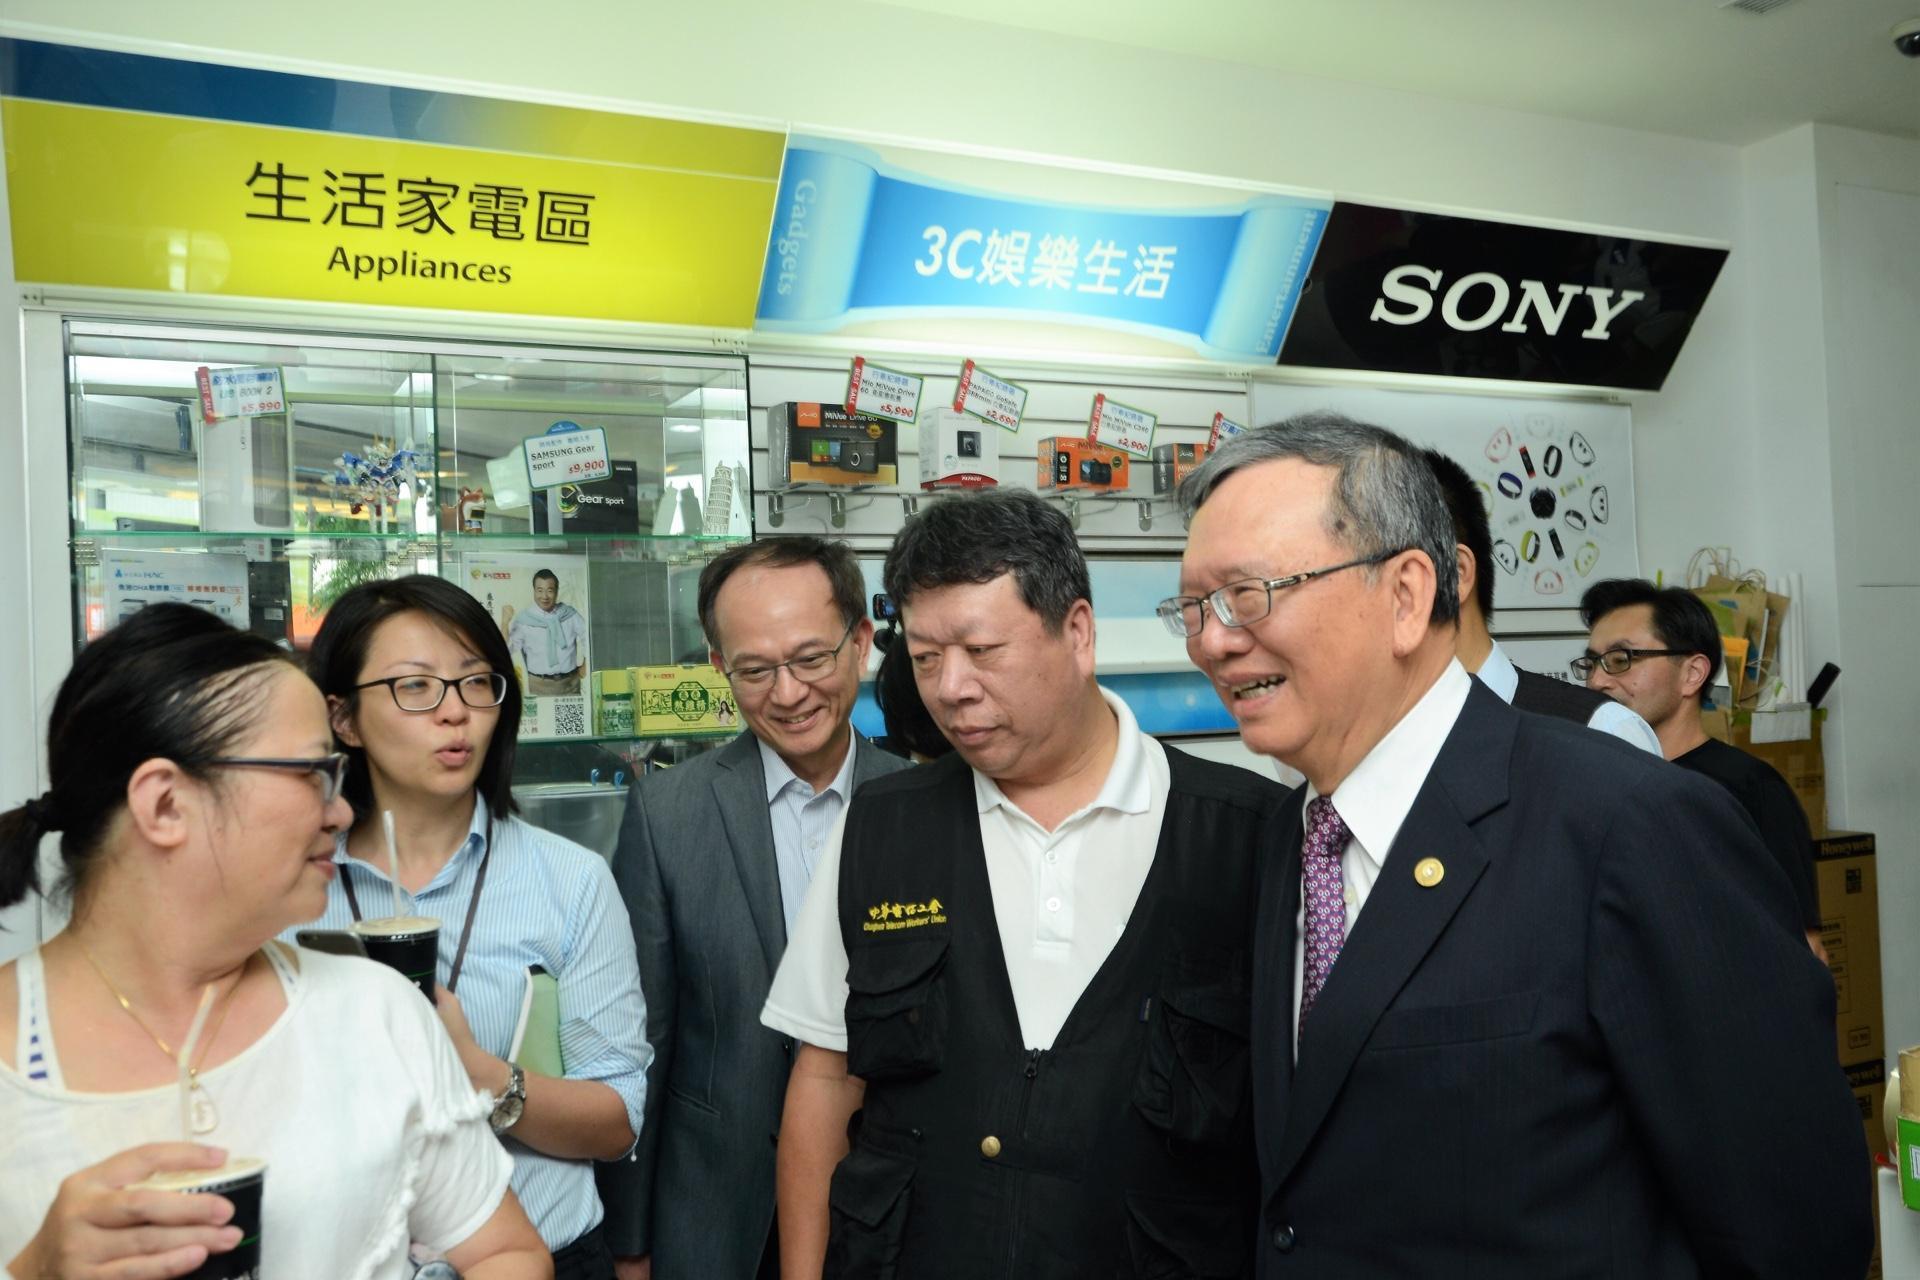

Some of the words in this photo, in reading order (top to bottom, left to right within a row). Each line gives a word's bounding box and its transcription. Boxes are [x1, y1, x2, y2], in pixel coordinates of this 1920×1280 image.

[246, 161, 596, 247] 生活家電區
[777, 179, 817, 296] Gadgets
[328, 246, 512, 284] Appliances
[914, 225, 1177, 300] 3C娛樂生活
[1256, 211, 1318, 354] Entertainment
[1370, 264, 1644, 340] SONY
[531, 447, 573, 461] SAMSUNG
[575, 445, 595, 454] Gear
[532, 460, 555, 471] sport
[568, 459, 605, 474] $9,900
[577, 494, 603, 504] Gear
[1821, 837, 1872, 857] Honeywell
